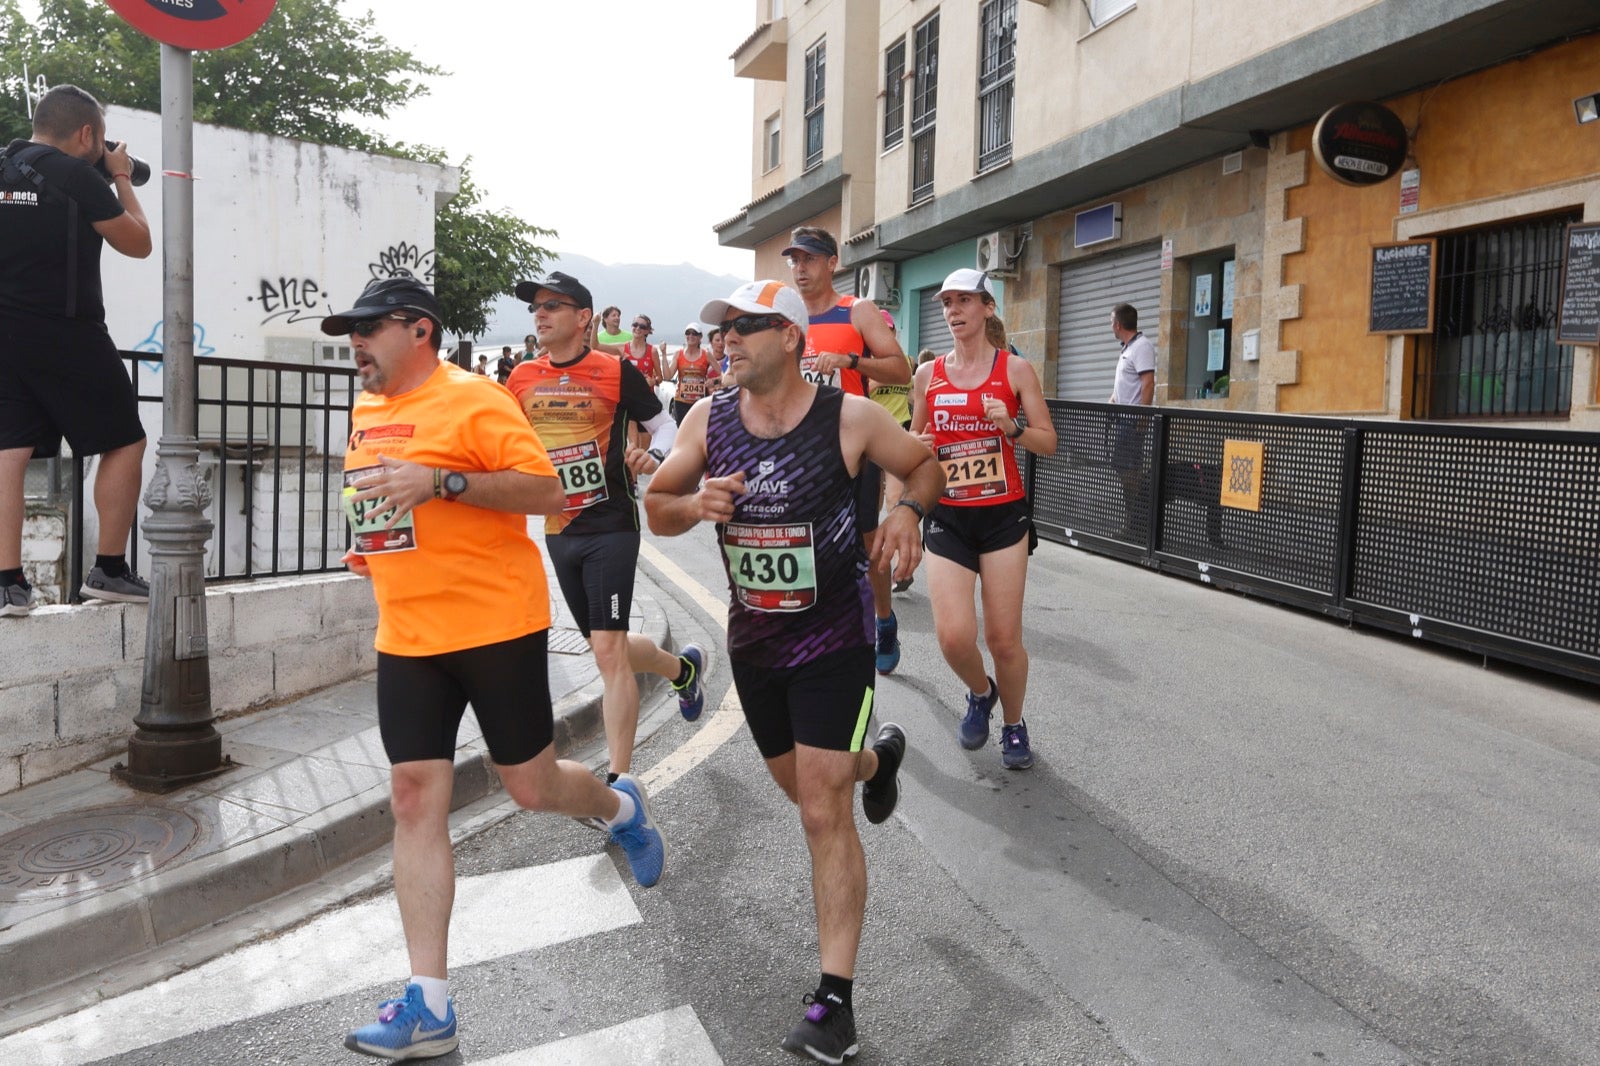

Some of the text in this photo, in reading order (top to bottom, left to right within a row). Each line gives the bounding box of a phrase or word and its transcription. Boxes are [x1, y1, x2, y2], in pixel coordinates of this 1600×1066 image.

[684, 384, 704, 392] 2043
[947, 457, 998, 482] 2121
[744, 480, 788, 494] WAVE
[738, 527, 753, 538] GRAN
[753, 527, 775, 539] PREMIO
[776, 528, 785, 538] DE
[785, 527, 806, 538] FONDO
[739, 552, 799, 584] 430
